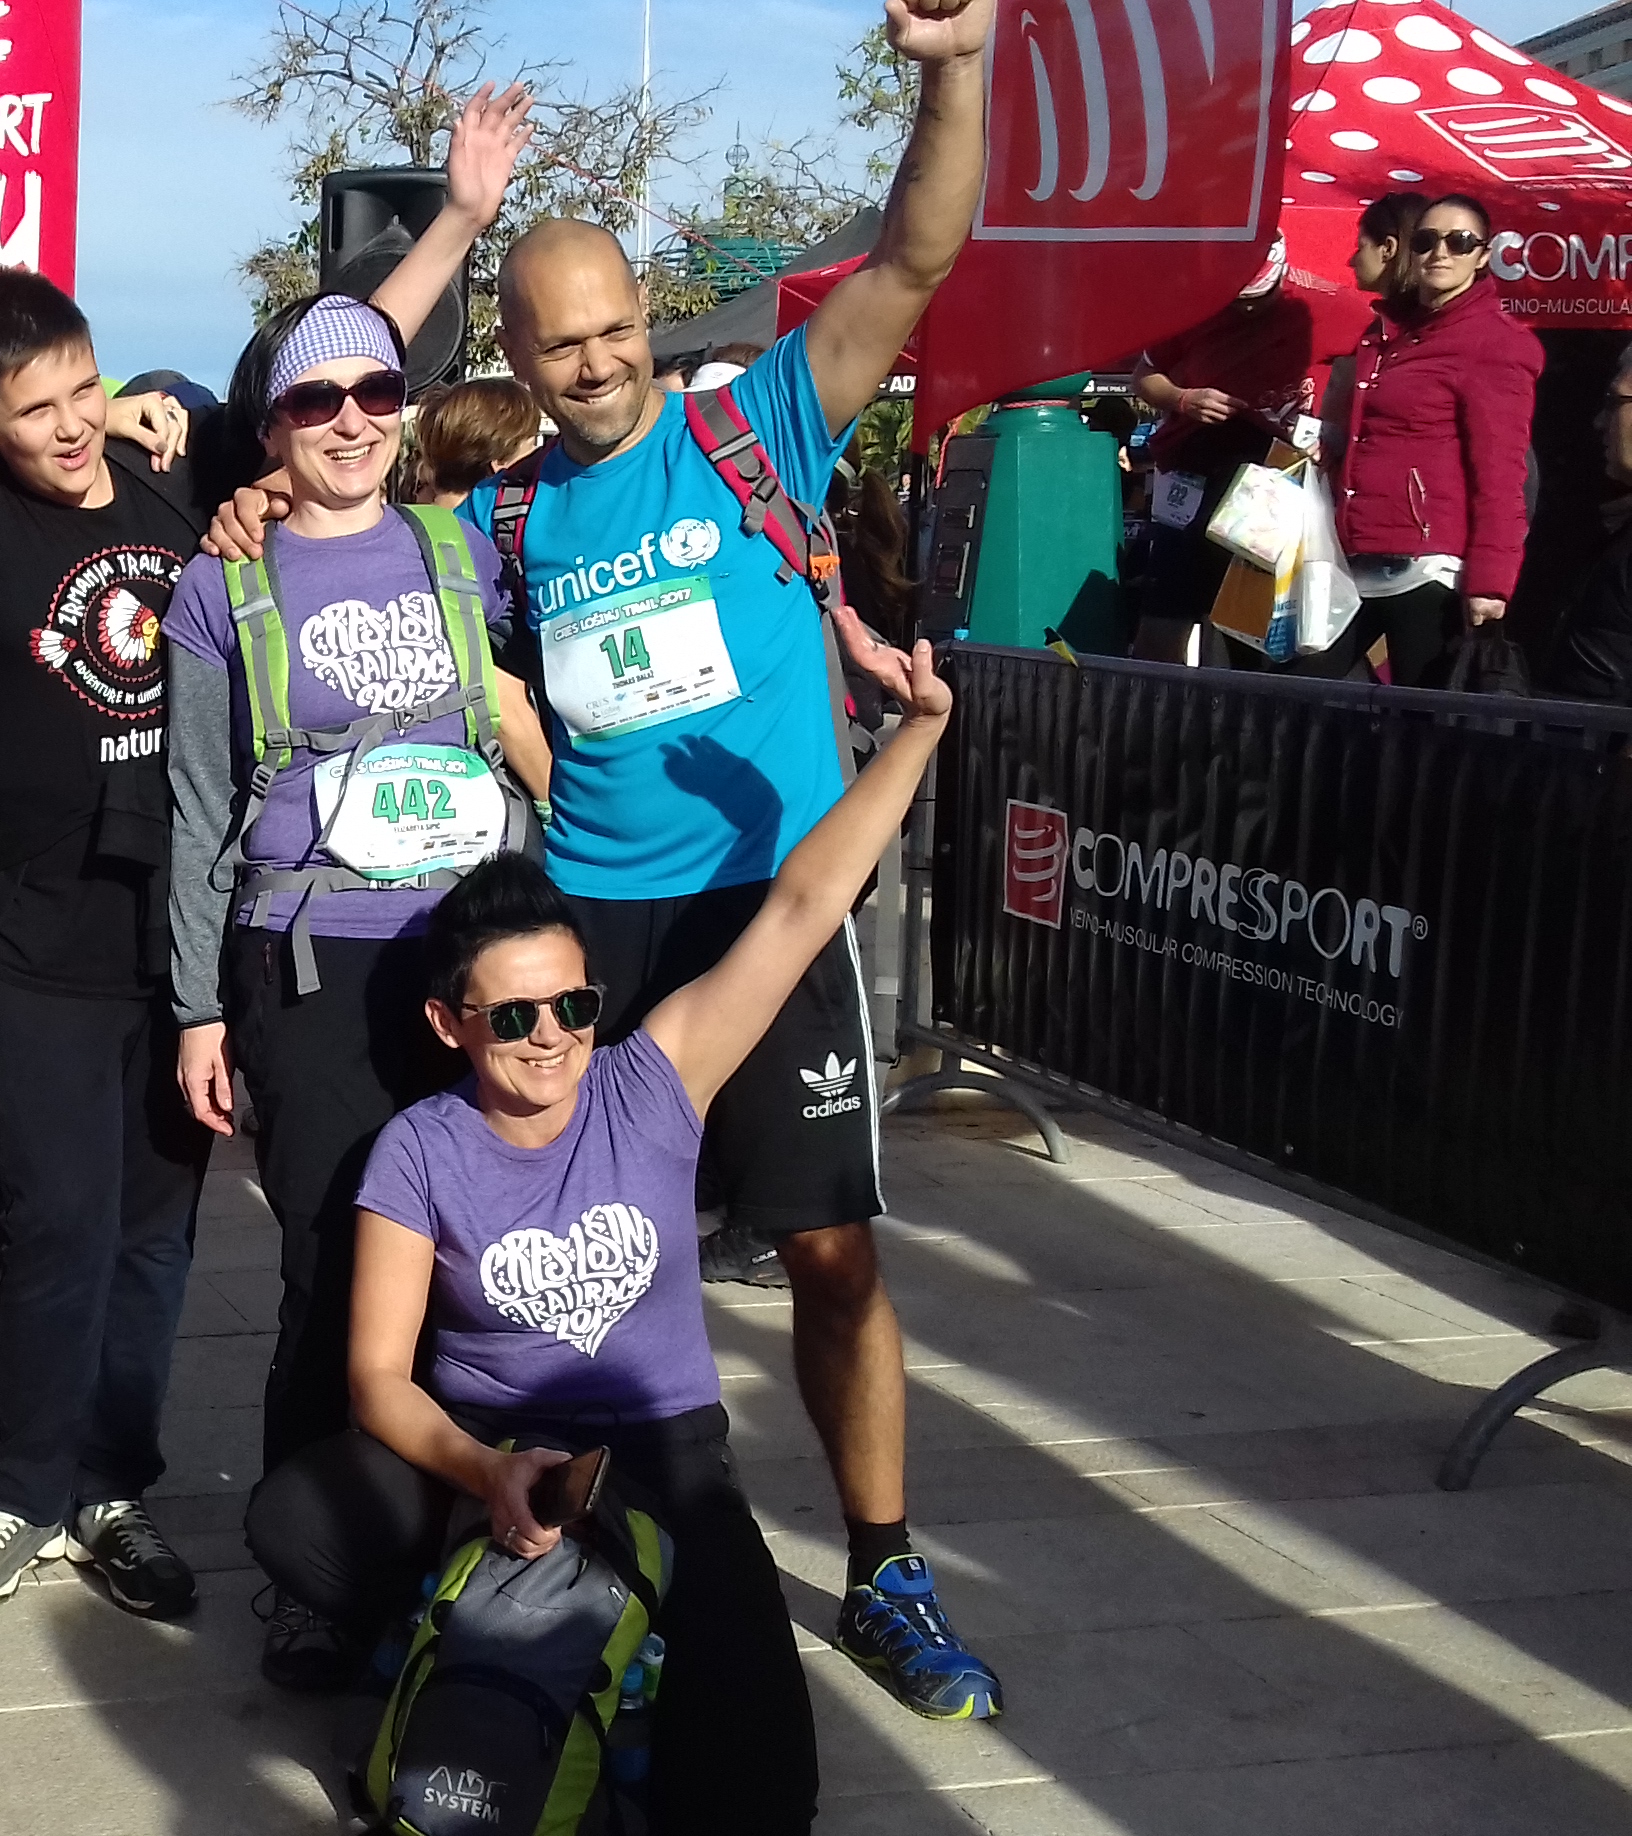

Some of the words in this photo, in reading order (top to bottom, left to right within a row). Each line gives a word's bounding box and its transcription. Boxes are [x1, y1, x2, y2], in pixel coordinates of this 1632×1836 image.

[1500, 298, 1632, 314] EINO-MUSCULA
[58, 558, 115, 627] ZRMANJA
[116, 551, 165, 578] TRAIL
[537, 532, 657, 615] unicef
[622, 597, 660, 618] TRAIL
[659, 587, 692, 607] 2017
[599, 626, 651, 679] 14
[73, 659, 124, 705] ADVENTURE
[100, 726, 163, 763] natur
[414, 756, 445, 772] TRAIL
[372, 779, 456, 823] 442
[1181, 943, 1293, 994] COMPRESSION
[1296, 976, 1405, 1029] TECHNOLOGY
[802, 1096, 862, 1118] adidas
[479, 1226, 571, 1302] CRES
[540, 1300, 636, 1359] 2017
[424, 1787, 500, 1824] SYSTEM
